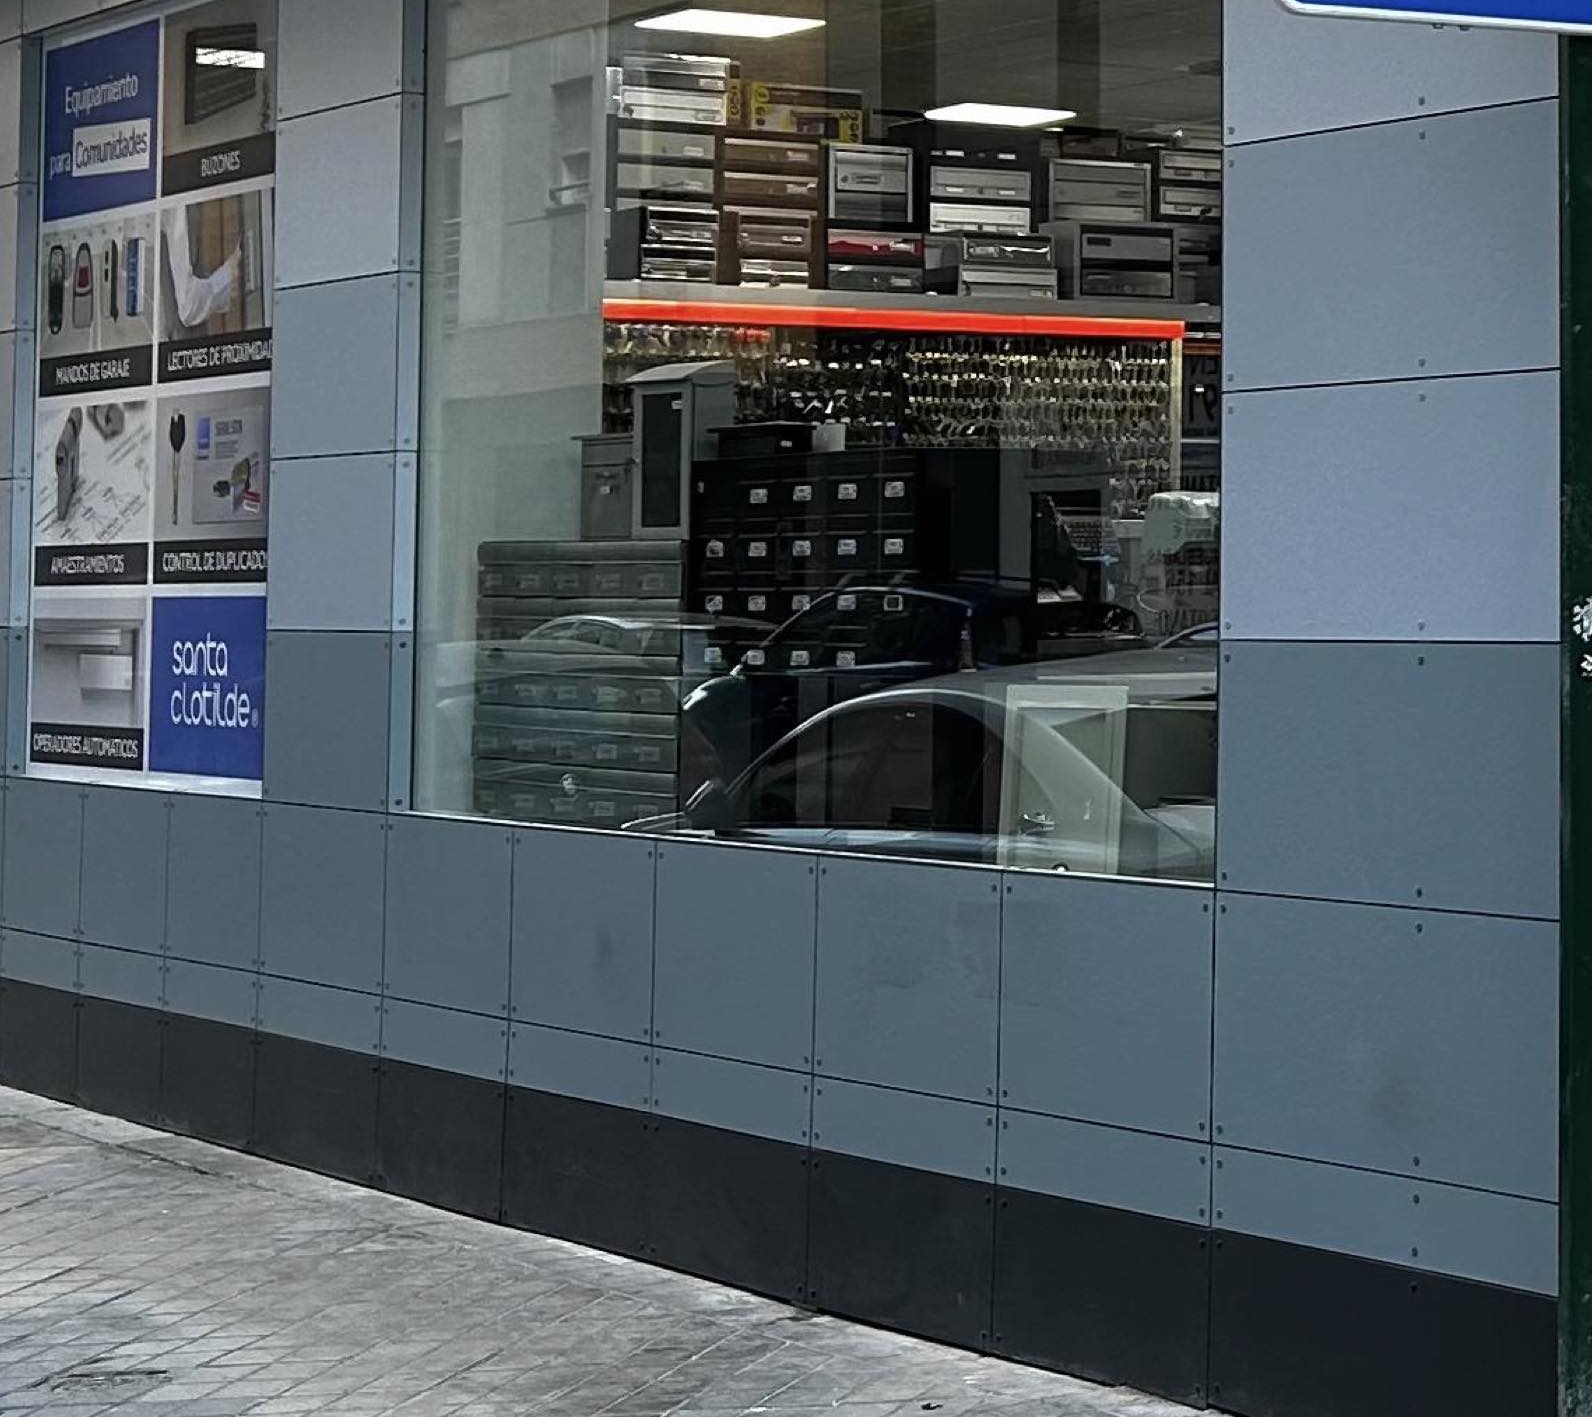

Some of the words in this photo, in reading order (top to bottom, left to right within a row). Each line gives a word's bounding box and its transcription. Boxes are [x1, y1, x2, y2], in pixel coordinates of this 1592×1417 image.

[65, 74, 139, 118] Equipamiento
[49, 151, 71, 180] para
[76, 127, 148, 169] Comunidades
[201, 150, 241, 177] BUZONES
[172, 632, 228, 677] santa
[170, 682, 250, 729] clotilde
